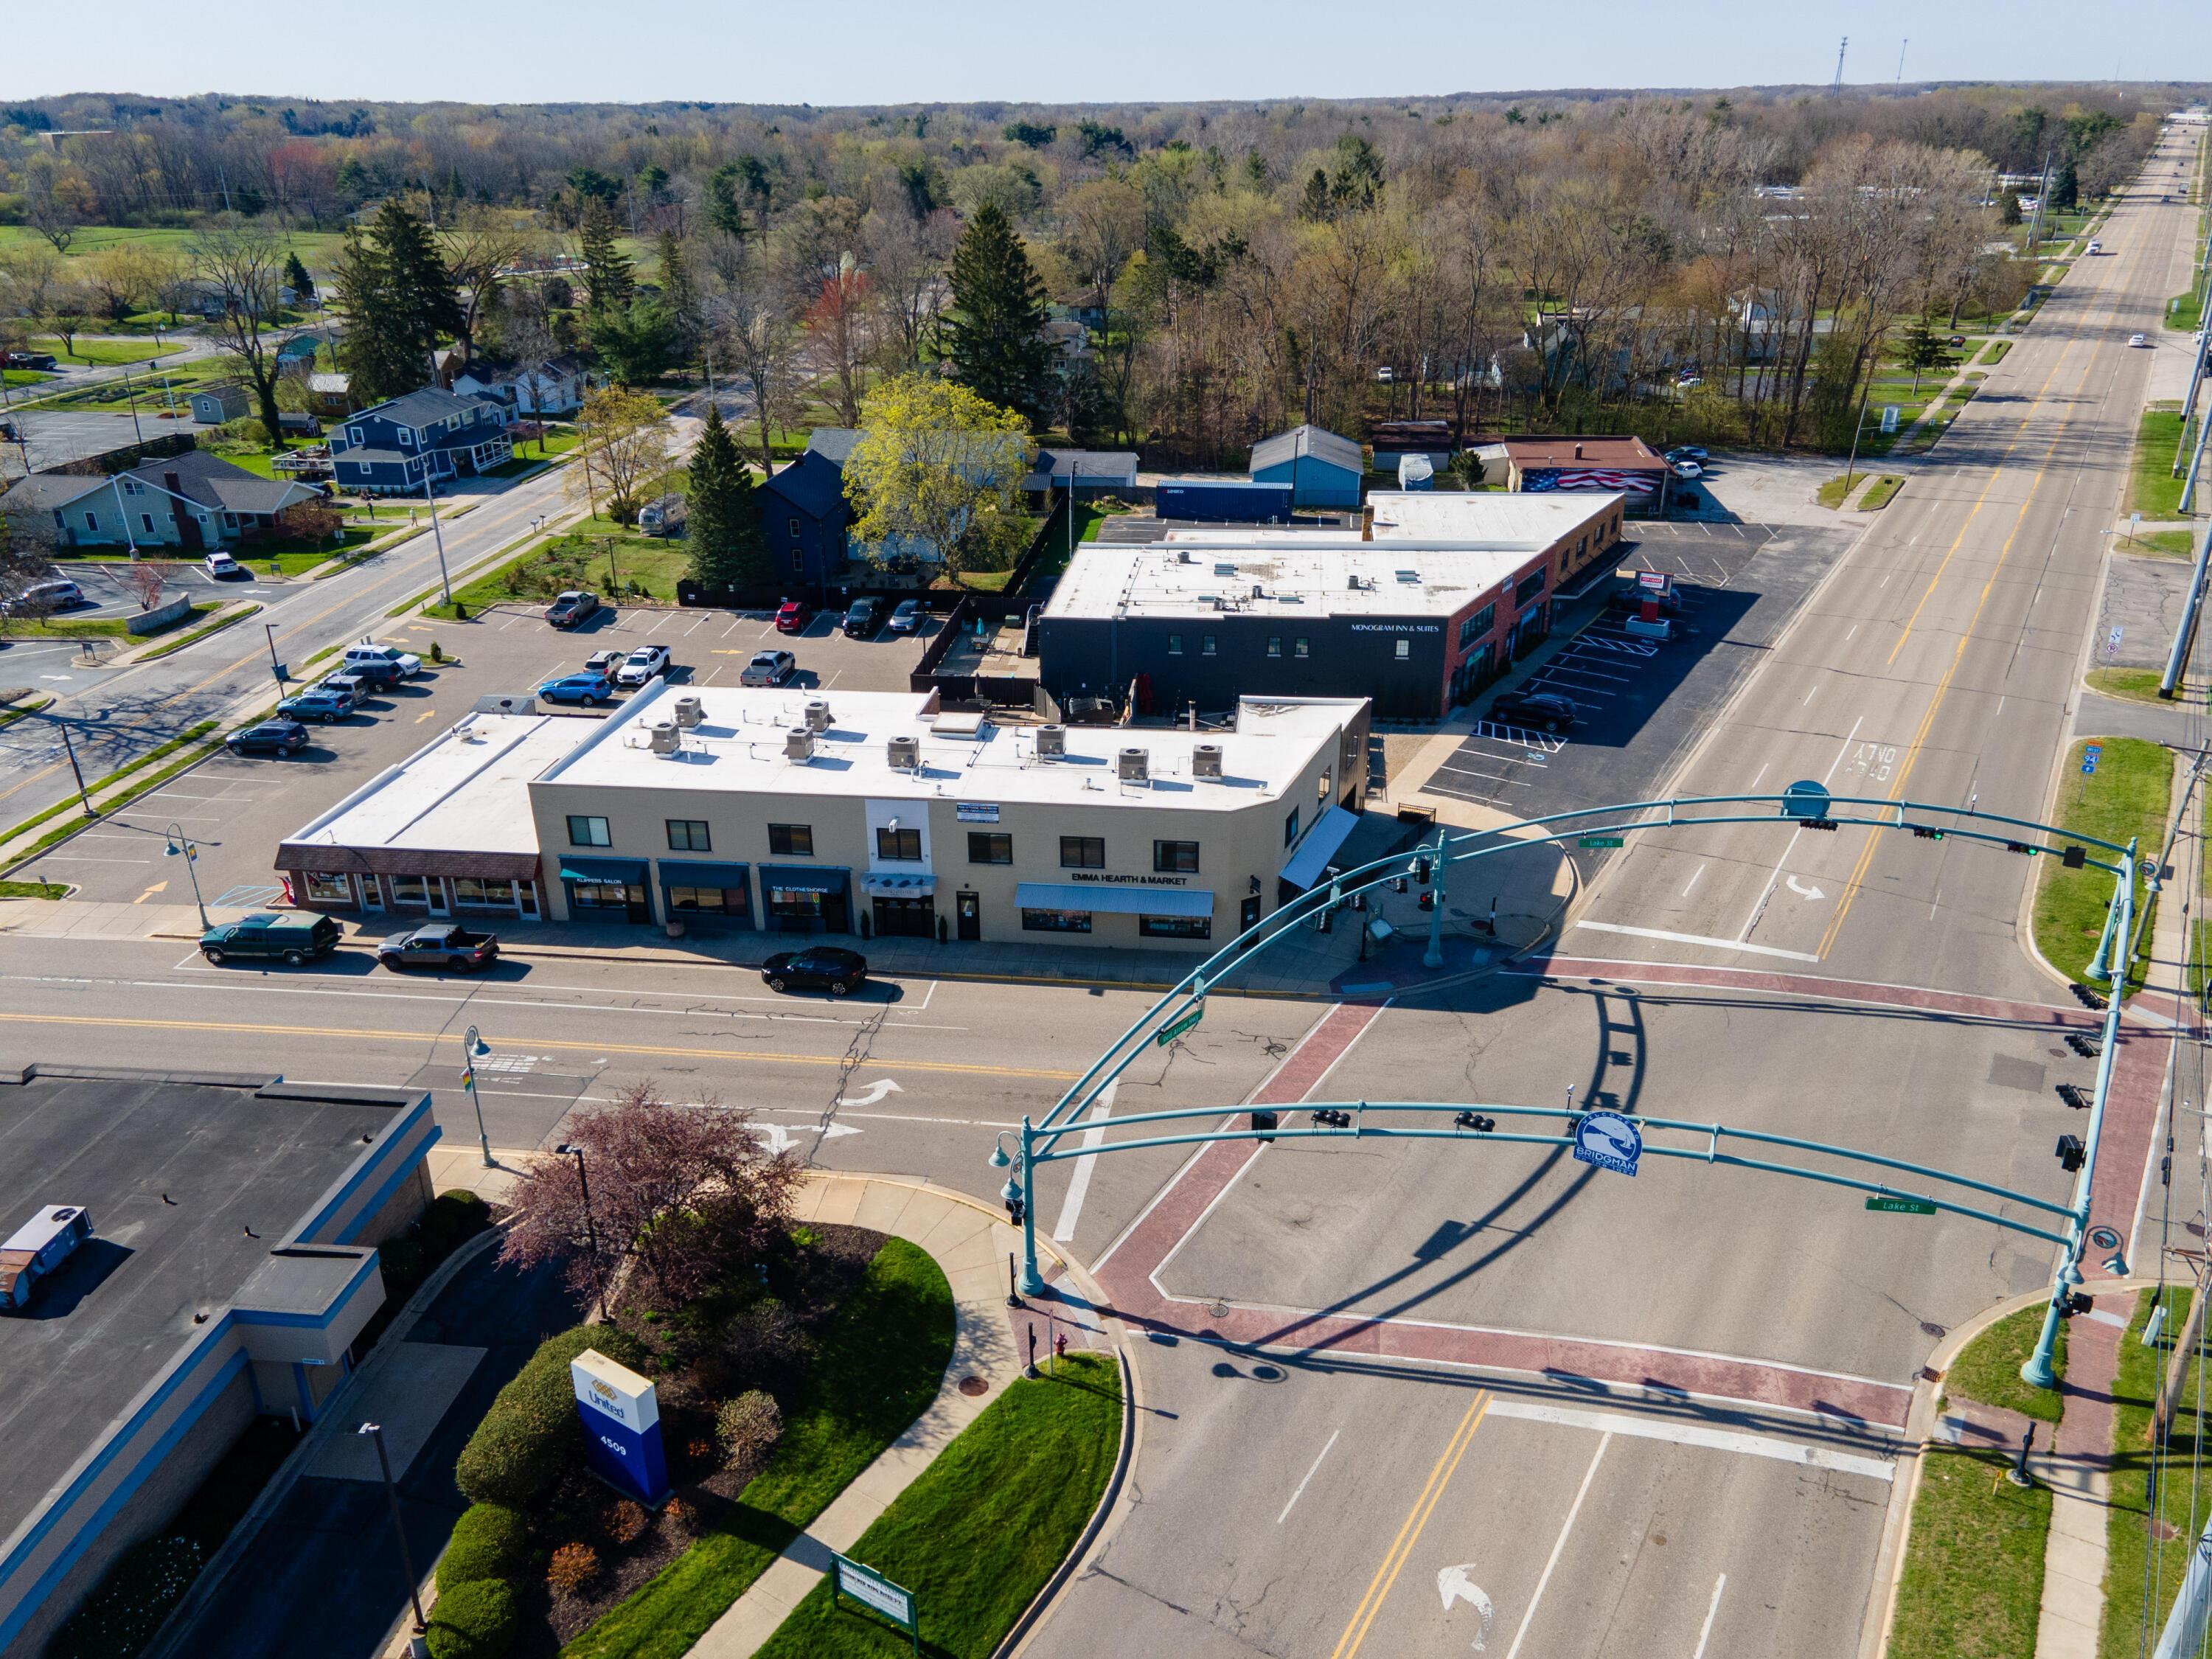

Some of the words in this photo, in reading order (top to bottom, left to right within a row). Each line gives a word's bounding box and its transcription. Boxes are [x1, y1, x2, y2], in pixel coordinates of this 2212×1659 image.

[1853, 742, 1897, 764] ONLY
[2084, 755, 2096, 764] 94
[1071, 873, 1099, 882] EMMA
[1101, 874, 1138, 883] HEARTH
[1140, 876, 1148, 884] &
[1148, 876, 1187, 886] MARKET
[1582, 1112, 1630, 1124] WELCOME
[1632, 1128, 1640, 1140] TO
[1576, 1147, 1636, 1171] BRIDGMAN
[1883, 1202, 1906, 1211] Lake
[1910, 1203, 1919, 1212] St
[588, 1390, 625, 1419] United
[600, 1436, 627, 1455] 4509
